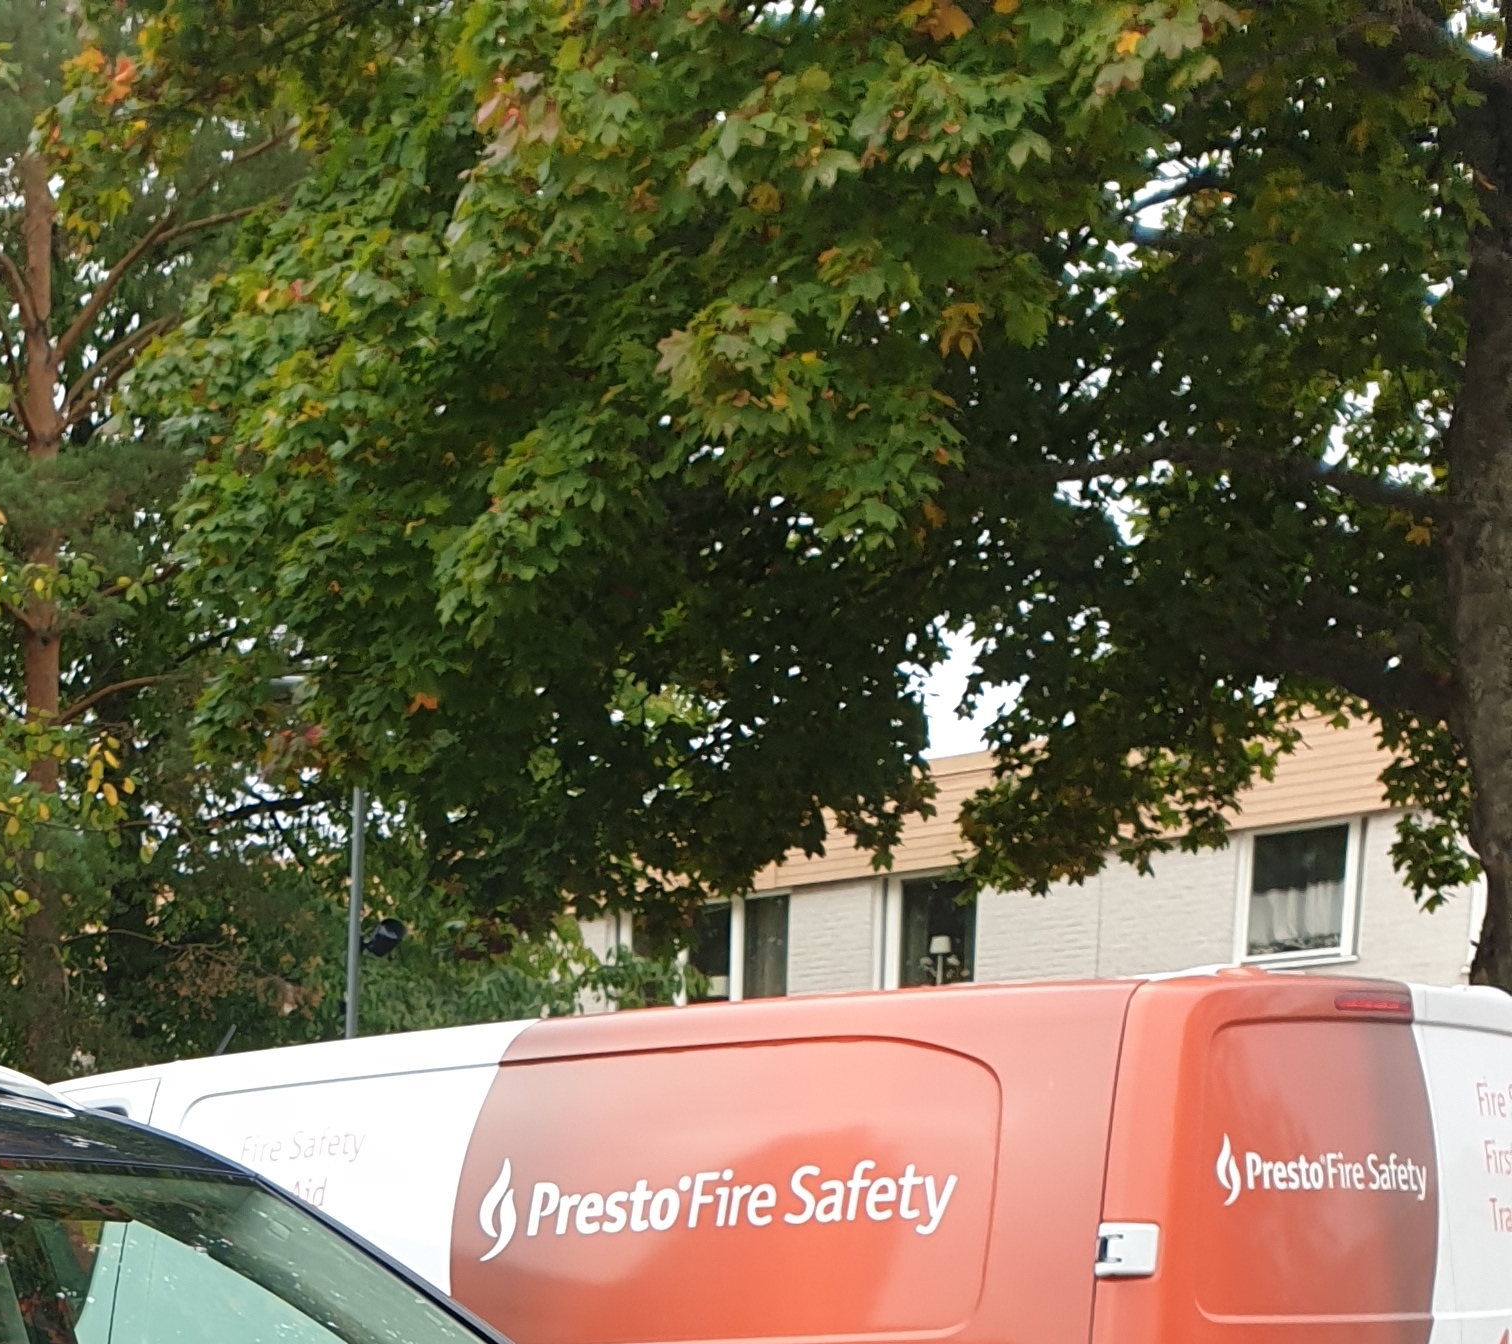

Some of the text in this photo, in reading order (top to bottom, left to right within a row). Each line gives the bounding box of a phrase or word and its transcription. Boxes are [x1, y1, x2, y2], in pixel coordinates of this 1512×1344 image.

[1475, 1076, 1506, 1119] Fire
[240, 1126, 366, 1163] Fire Safety
[1483, 1138, 1512, 1176] Firs
[784, 1160, 959, 1236] Safety
[1367, 1152, 1427, 1201] Safety
